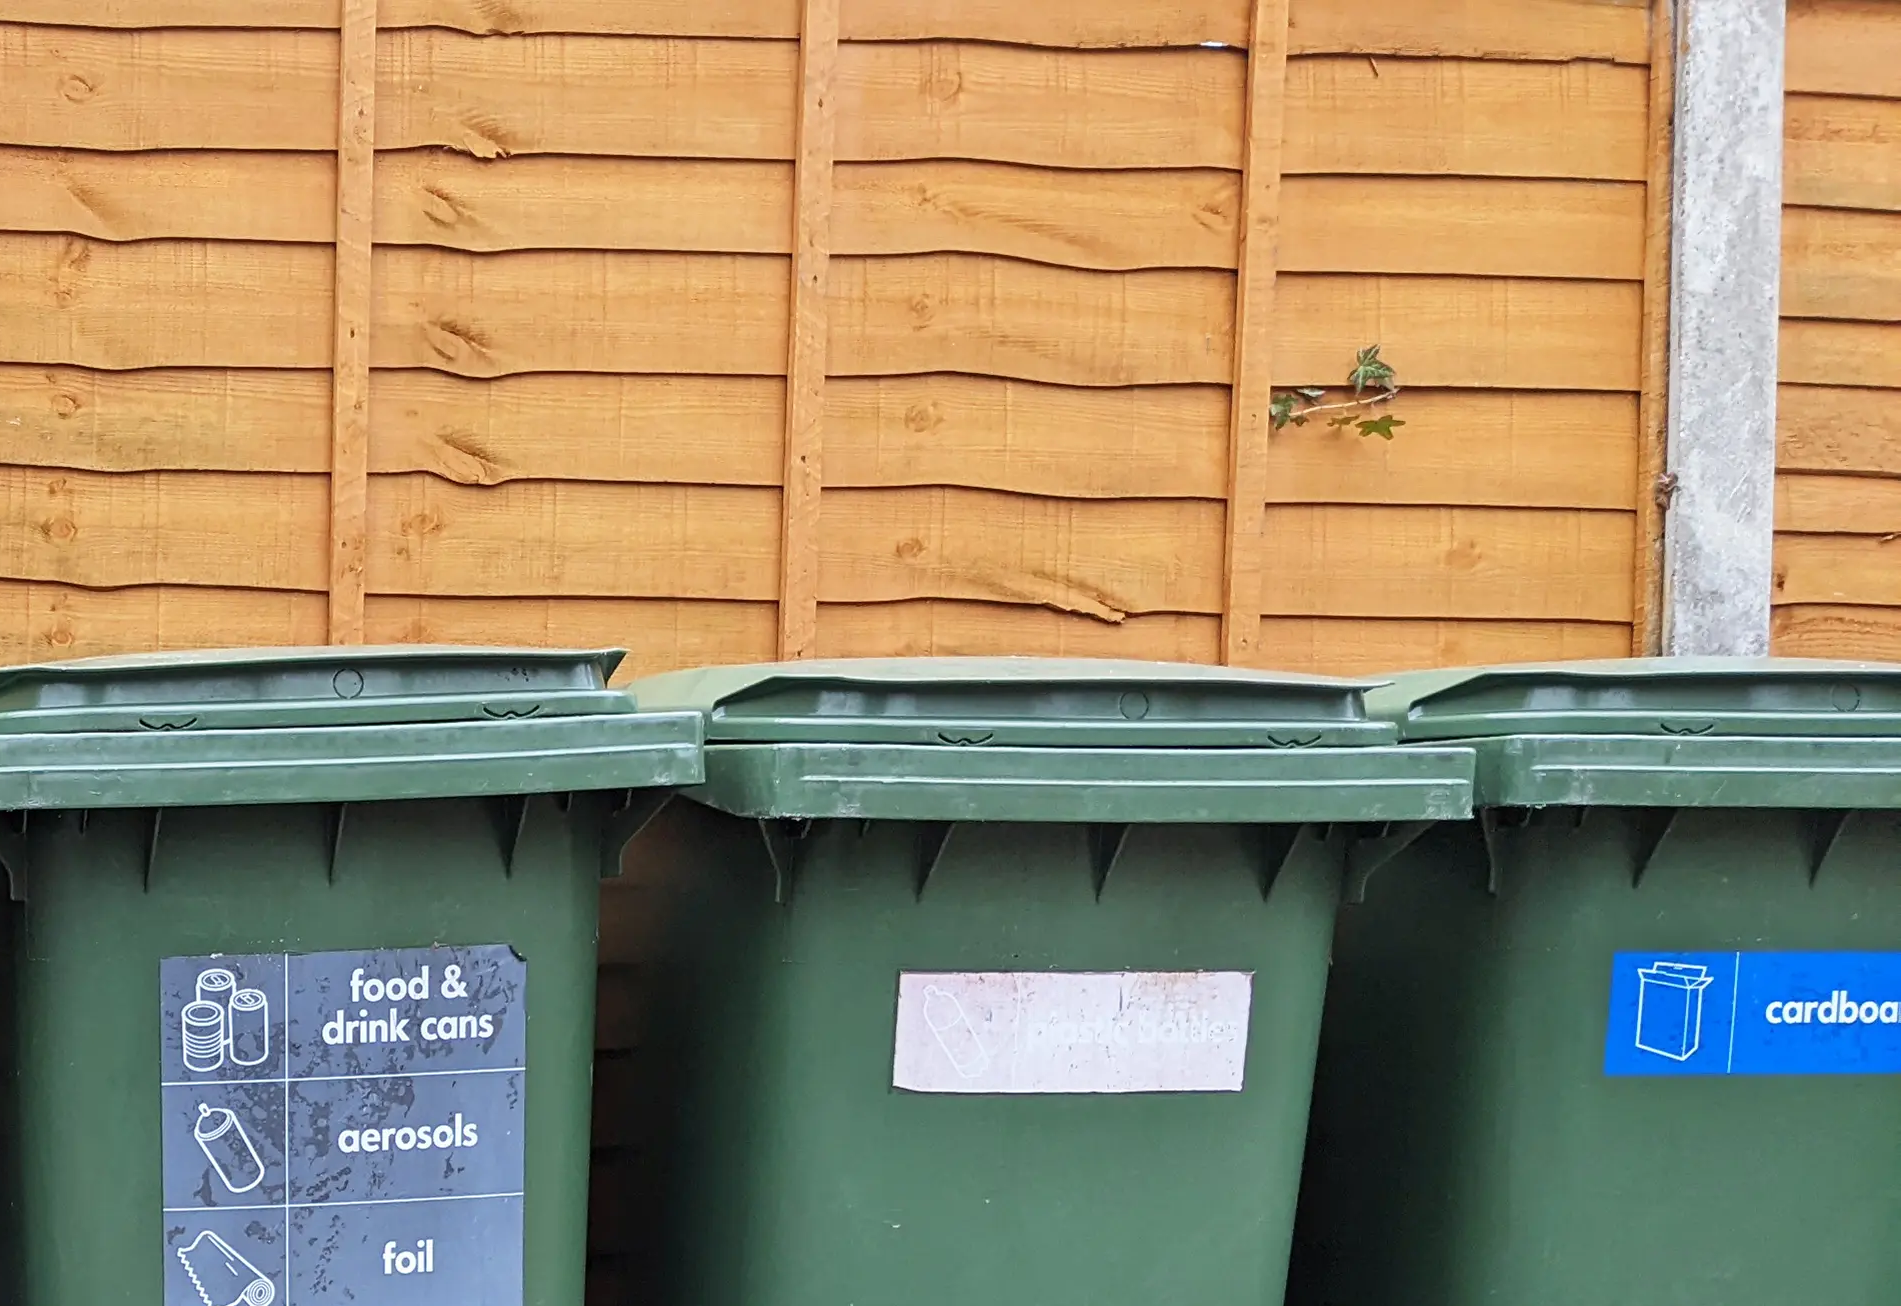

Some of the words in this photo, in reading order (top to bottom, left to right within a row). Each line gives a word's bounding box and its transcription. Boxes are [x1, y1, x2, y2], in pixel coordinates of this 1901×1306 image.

[349, 965, 430, 1003] food
[440, 964, 469, 1000] &
[1765, 989, 1901, 1025] cardboa
[321, 1008, 410, 1046] drink
[419, 1013, 495, 1041] cans
[337, 1112, 479, 1154] aerosols
[382, 1238, 435, 1276] foil
